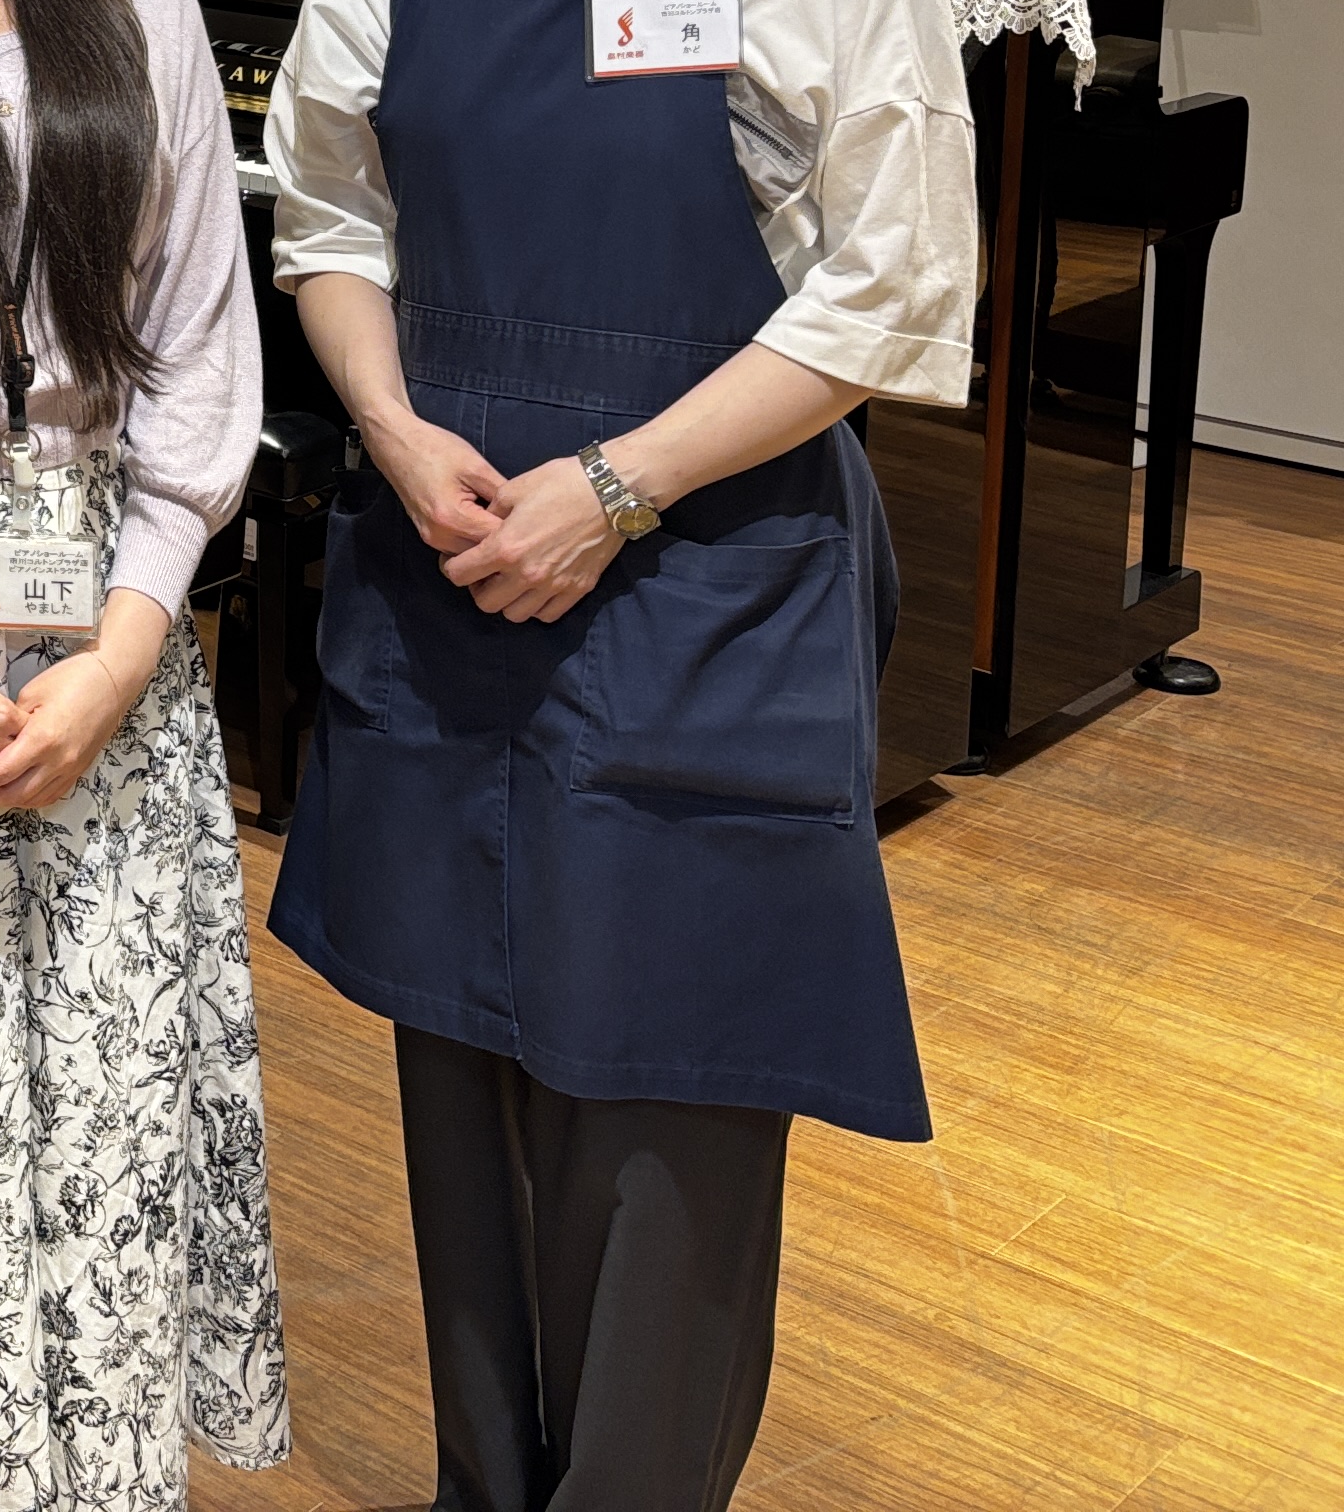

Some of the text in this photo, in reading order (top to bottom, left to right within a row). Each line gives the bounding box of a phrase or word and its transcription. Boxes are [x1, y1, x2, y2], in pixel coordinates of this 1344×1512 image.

[681, 22, 700, 43] 角
[683, 45, 701, 54] かど
[216, 63, 274, 85] AW
[14, 549, 84, 558] ピアノショールーム
[8, 566, 89, 575] ピアノインストラクター
[24, 578, 74, 601] 山下
[24, 602, 74, 615] やました
